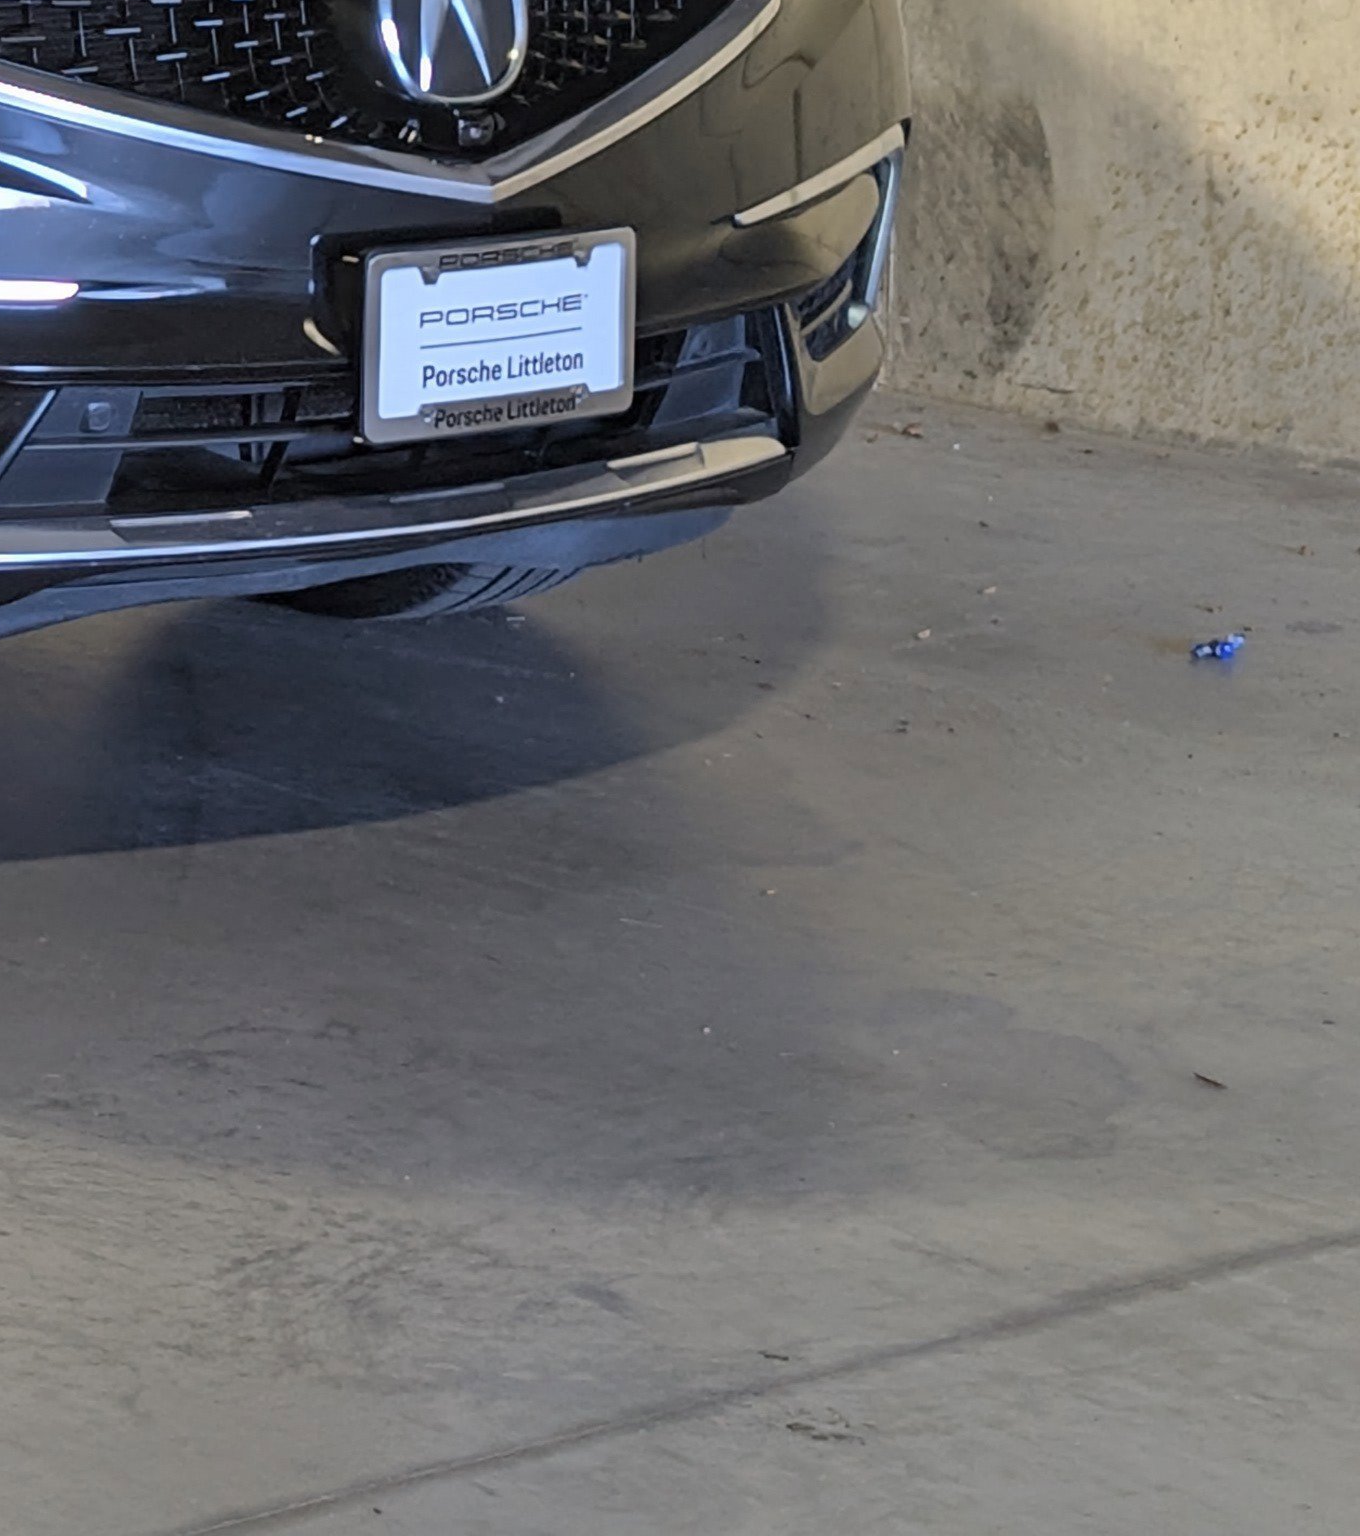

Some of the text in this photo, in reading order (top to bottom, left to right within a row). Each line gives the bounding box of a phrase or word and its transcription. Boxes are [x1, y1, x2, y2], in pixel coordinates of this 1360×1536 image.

[438, 240, 575, 268] PORSCHE
[419, 293, 582, 329] PORSCHE
[422, 351, 584, 389] Porsche Littleton
[434, 395, 577, 429] Porsche Littleton
